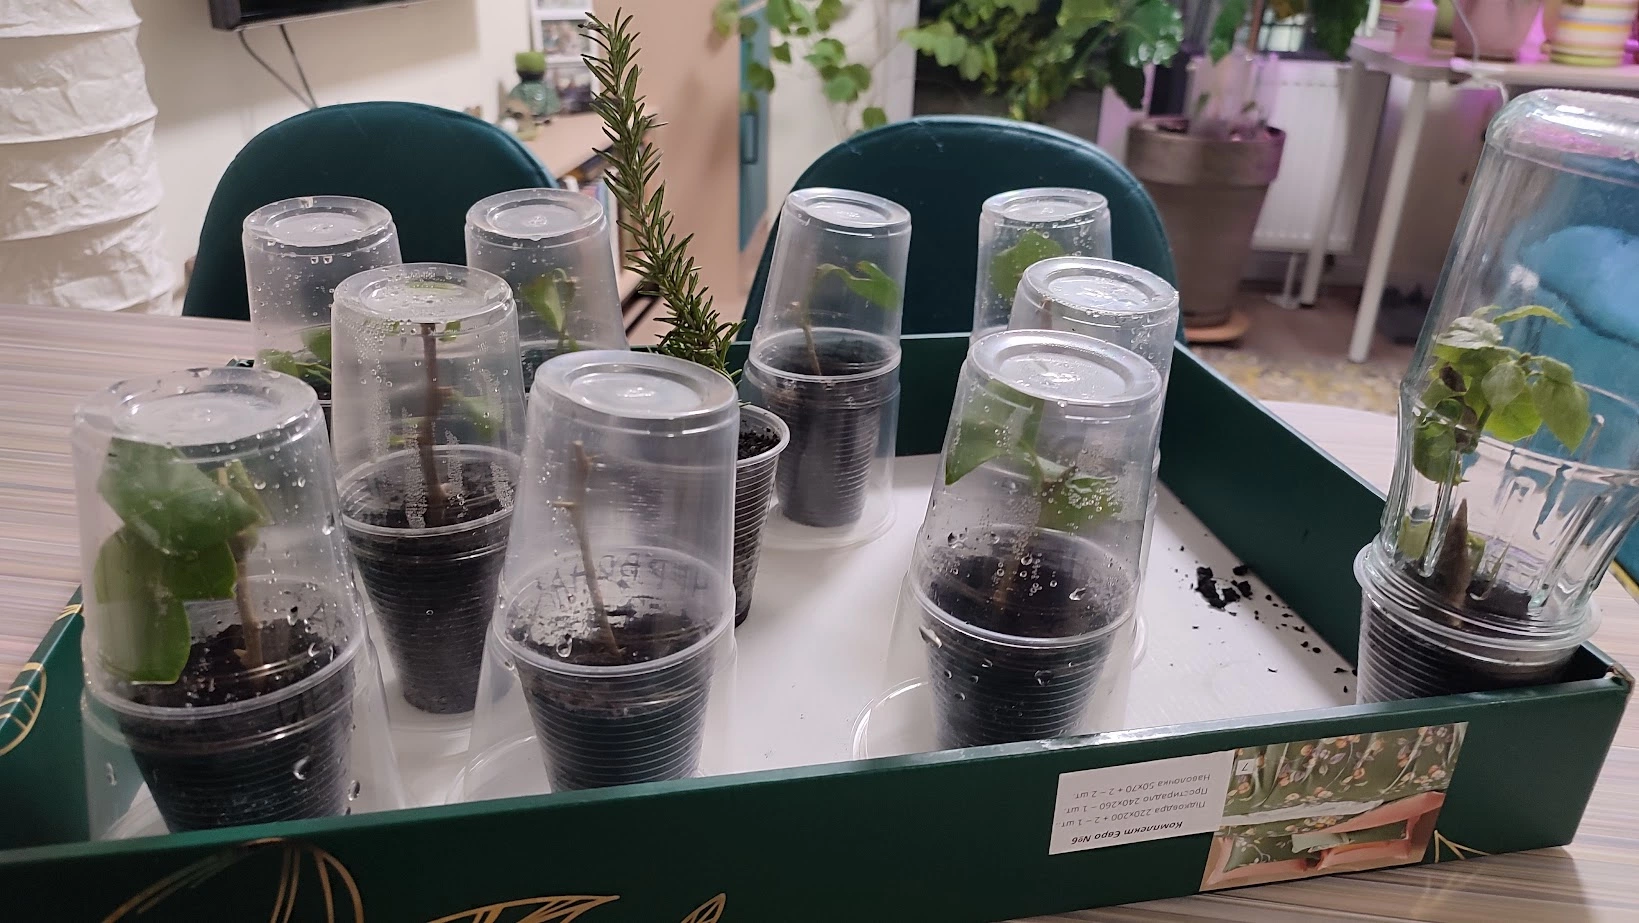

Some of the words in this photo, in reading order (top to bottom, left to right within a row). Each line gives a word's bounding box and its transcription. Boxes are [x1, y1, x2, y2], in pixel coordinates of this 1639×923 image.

[1241, 762, 1249, 772] 7
[1157, 774, 1211, 788] Наволочка
[1108, 788, 1115, 796] 2
[1143, 787, 1208, 802] Простирадло
[1154, 801, 1206, 814] Підковдра
[1094, 816, 1100, 824] 2
[1124, 821, 1183, 834] Комплект
[1071, 835, 1092, 845] №6
